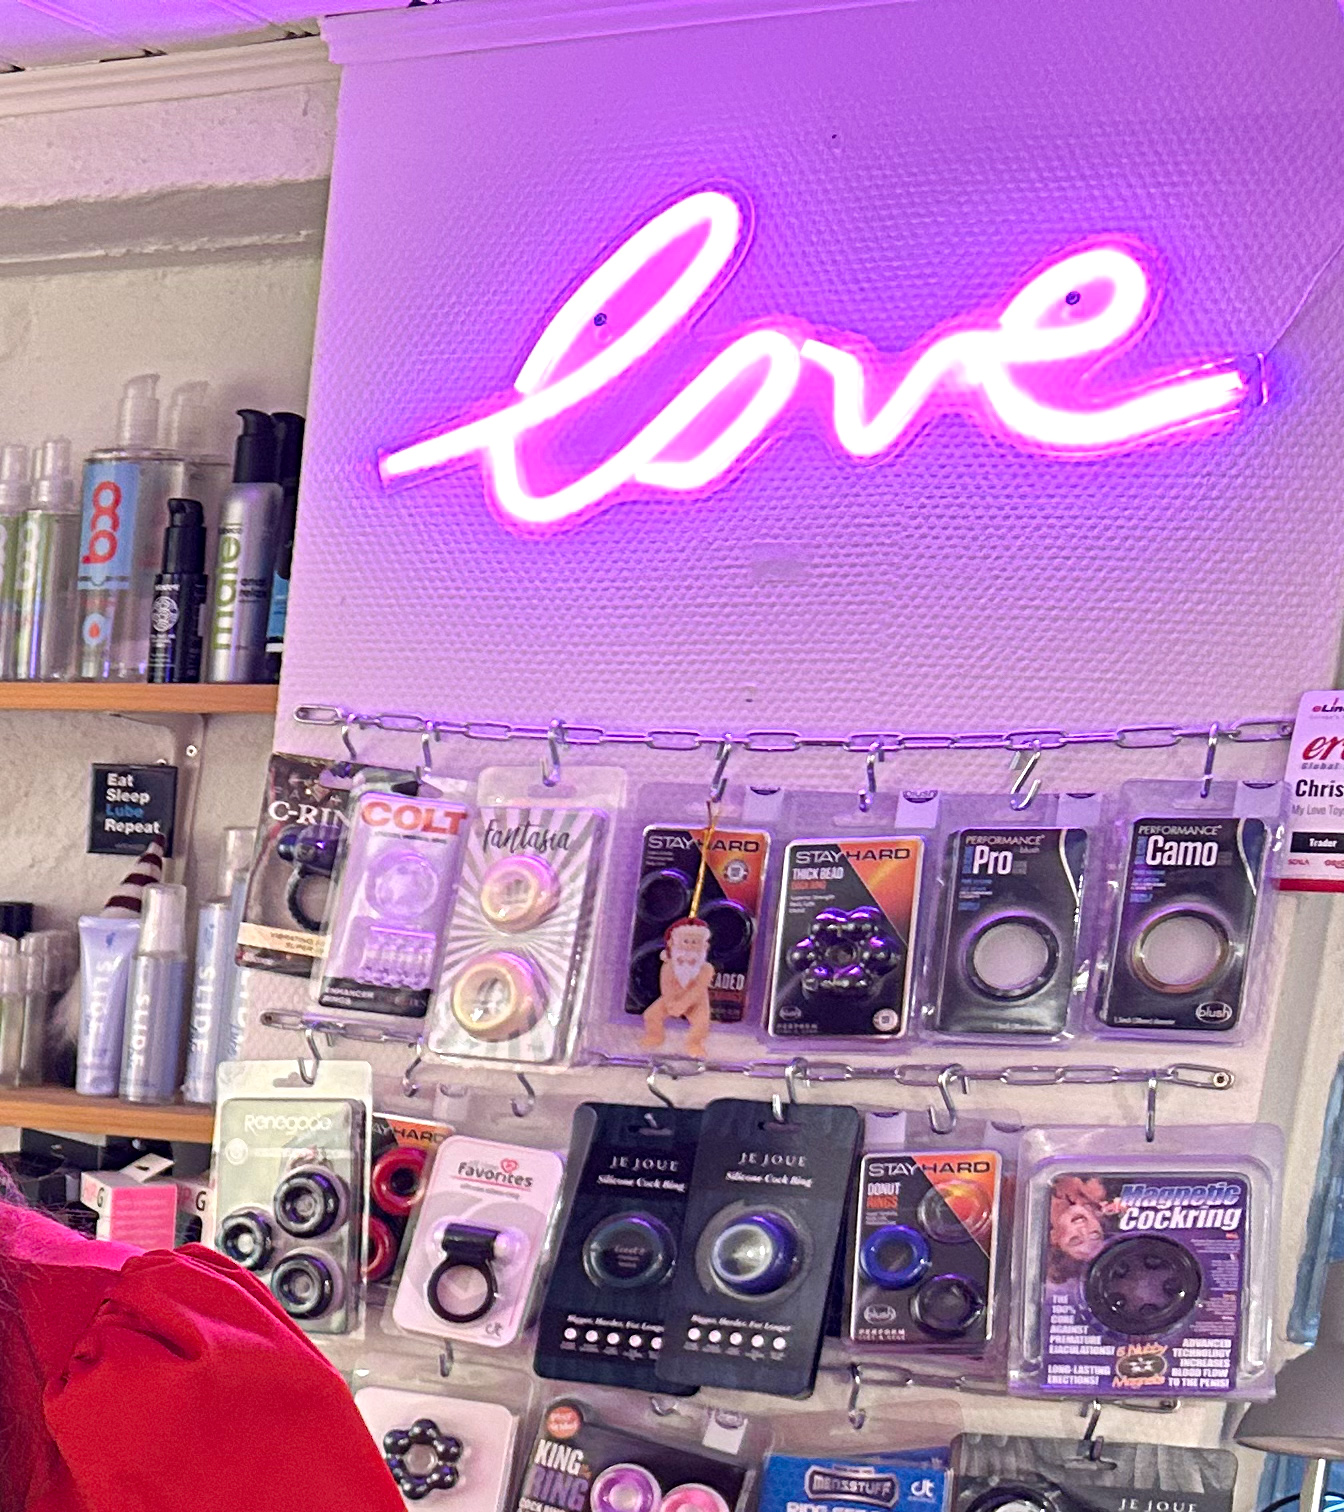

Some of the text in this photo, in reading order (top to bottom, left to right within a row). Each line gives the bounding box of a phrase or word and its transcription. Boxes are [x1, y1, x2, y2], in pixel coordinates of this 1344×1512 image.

[378, 188, 1246, 524] love
[1311, 696, 1344, 714] eLin
[106, 772, 135, 788] Eat
[105, 788, 151, 806] Sleep
[105, 804, 145, 819] Lube
[360, 801, 468, 836] COLT
[104, 819, 161, 836] Repeat
[1145, 834, 1219, 867] Camo
[972, 846, 1013, 876] Pro
[190, 965, 217, 1056] SLIDE
[1197, 1004, 1231, 1021] blush
[244, 1114, 333, 1136] Renegade
[609, 1155, 680, 1173] JE JOUE
[738, 1151, 808, 1168] JE JOUE
[457, 1159, 534, 1189] Favorites
[867, 1182, 901, 1196] DONUT
[1119, 1181, 1241, 1209] Magnetic
[1118, 1206, 1242, 1232] Cockring
[533, 1438, 586, 1477] KING
[1118, 1498, 1139, 1512] JE
